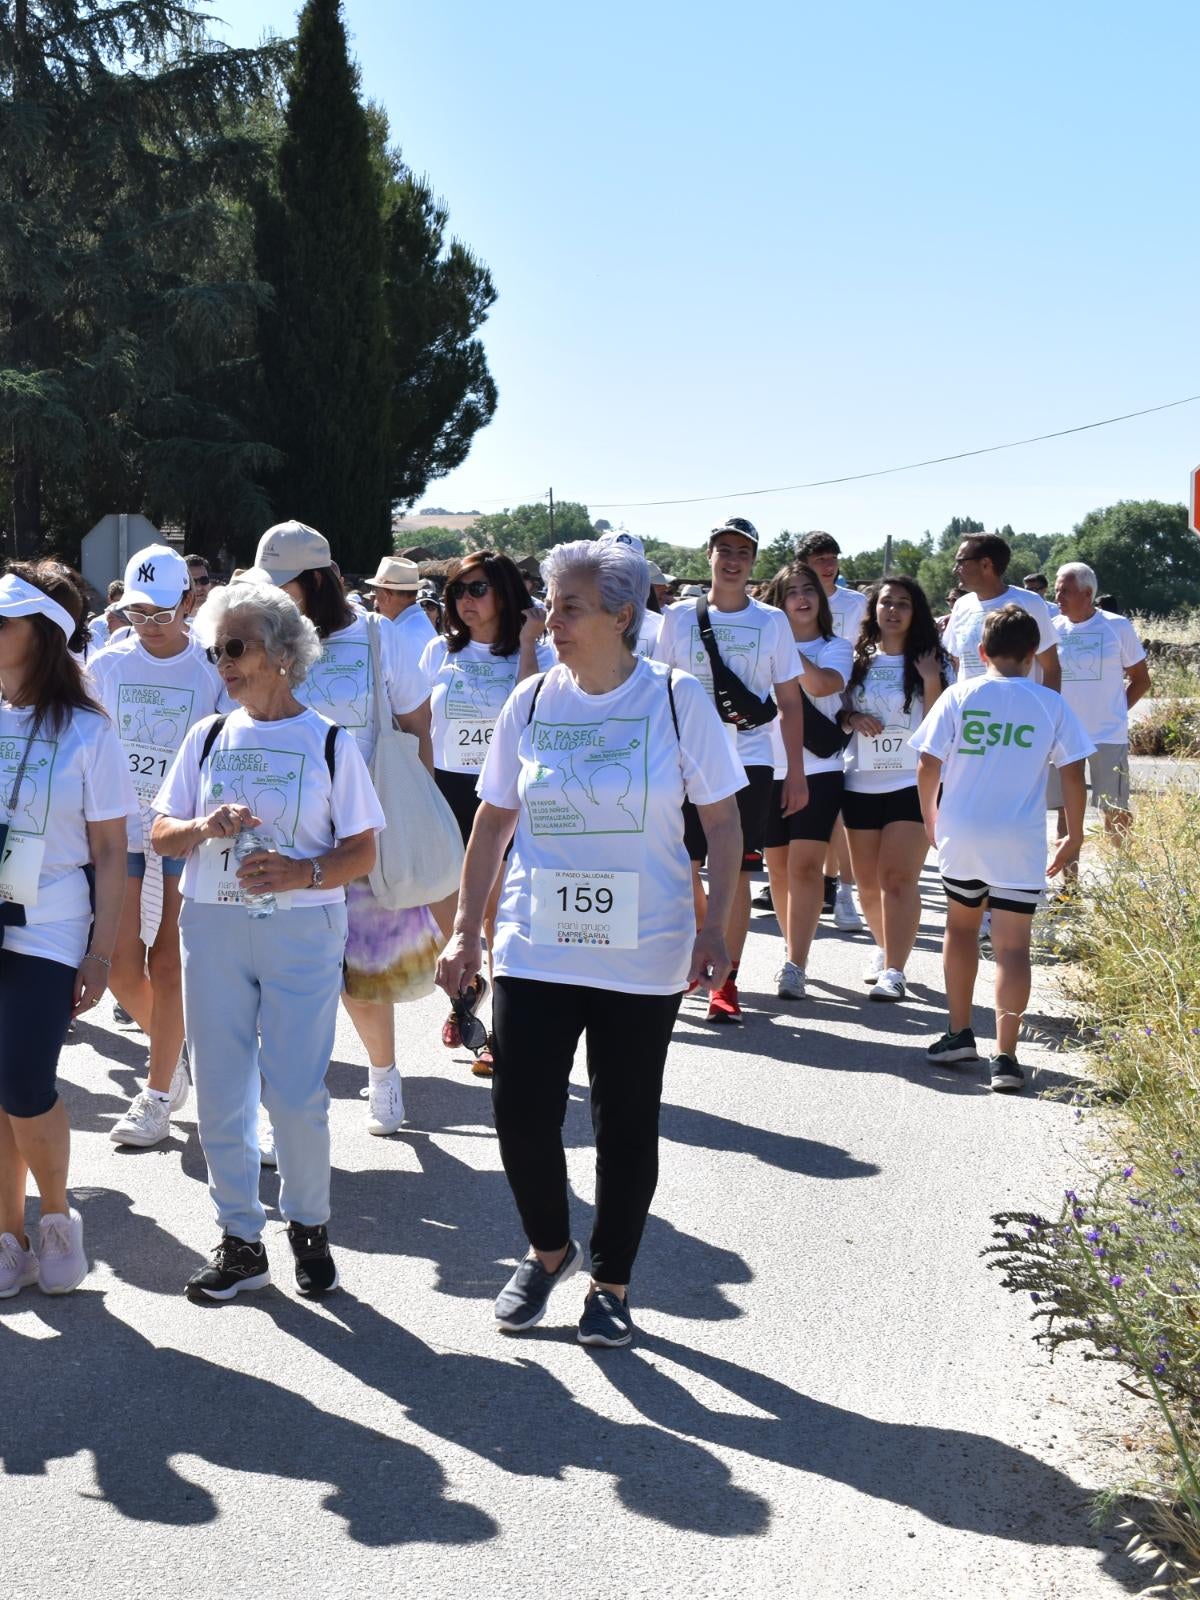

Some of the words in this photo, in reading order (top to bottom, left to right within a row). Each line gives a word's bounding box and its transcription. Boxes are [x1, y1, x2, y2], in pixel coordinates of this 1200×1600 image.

[132, 689, 160, 698] PASEO
[121, 696, 165, 706] SALUDABLE
[458, 728, 494, 746] 246
[538, 729, 550, 740] IX
[872, 738, 903, 752] 107
[229, 753, 263, 764] PASEO
[128, 753, 167, 777] 321
[215, 763, 269, 772] SALUDABLE
[557, 886, 613, 913] 159
[558, 922, 578, 930] nani
[581, 923, 610, 932] grupo
[558, 931, 609, 939] EMPRESARIAL
